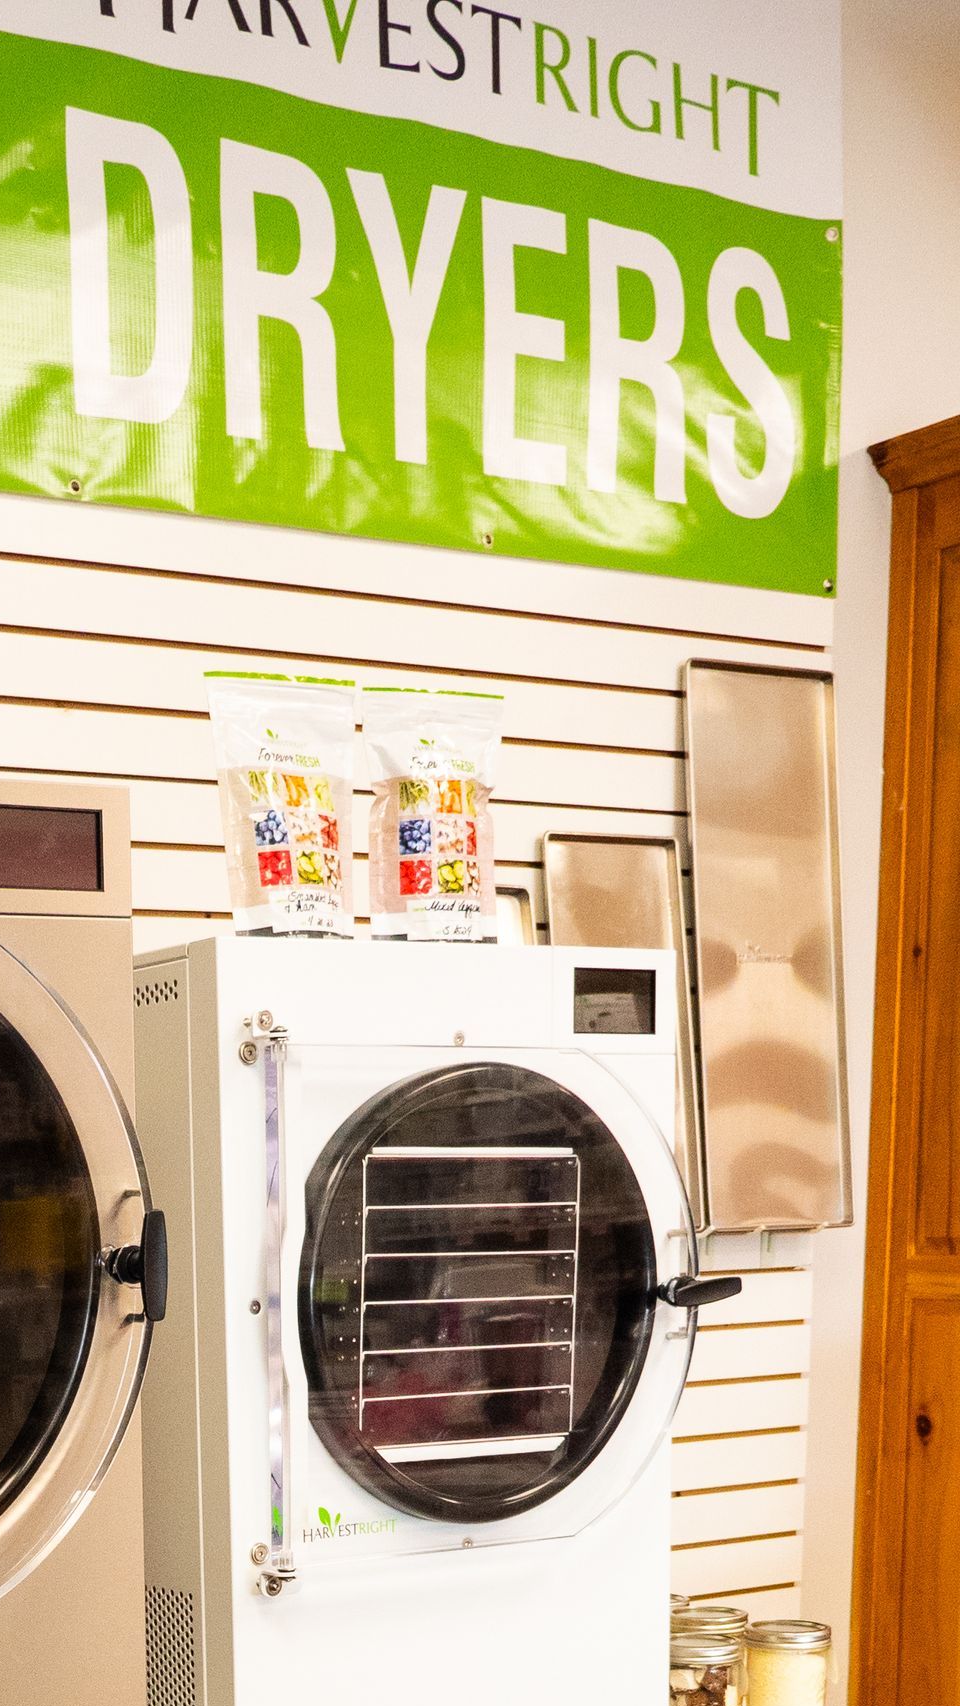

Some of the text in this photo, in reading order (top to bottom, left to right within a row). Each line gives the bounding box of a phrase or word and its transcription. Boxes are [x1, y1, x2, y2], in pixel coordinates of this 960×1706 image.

[100, 0, 781, 178] VESTRIGHT
[65, 106, 805, 520] DRYERS
[302, 1510, 398, 1543] HARVESTRIGHT
